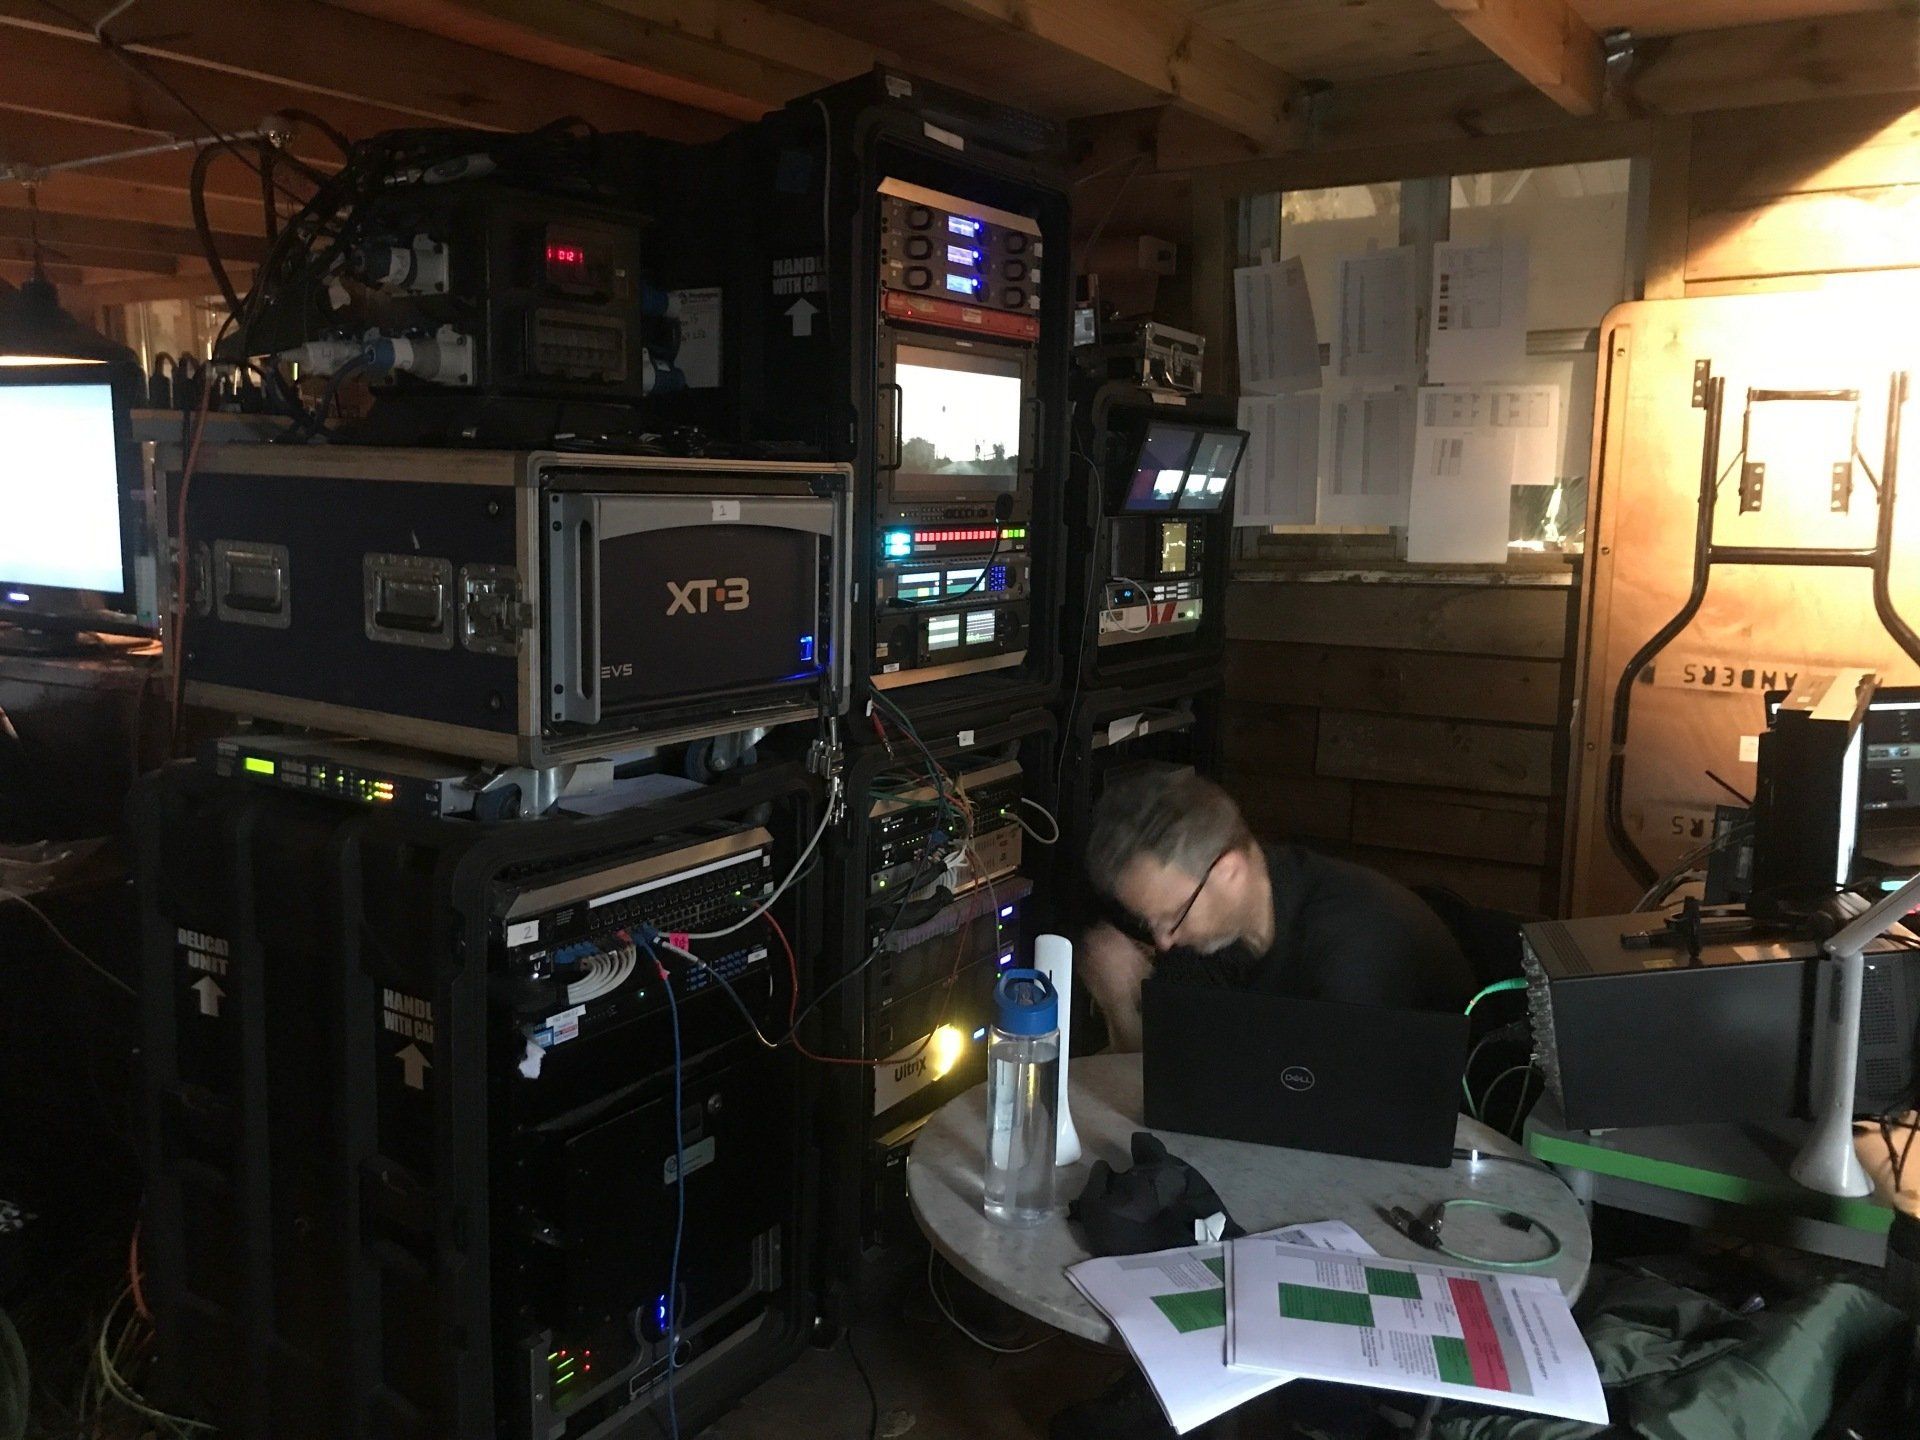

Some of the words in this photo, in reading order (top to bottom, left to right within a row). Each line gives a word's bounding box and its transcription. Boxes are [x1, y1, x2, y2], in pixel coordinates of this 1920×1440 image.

[773, 257, 826, 276] HANDL
[601, 663, 633, 679] EVS
[178, 927, 229, 957] DELICAT
[523, 926, 533, 940] 2
[383, 988, 434, 1021] HANDL
